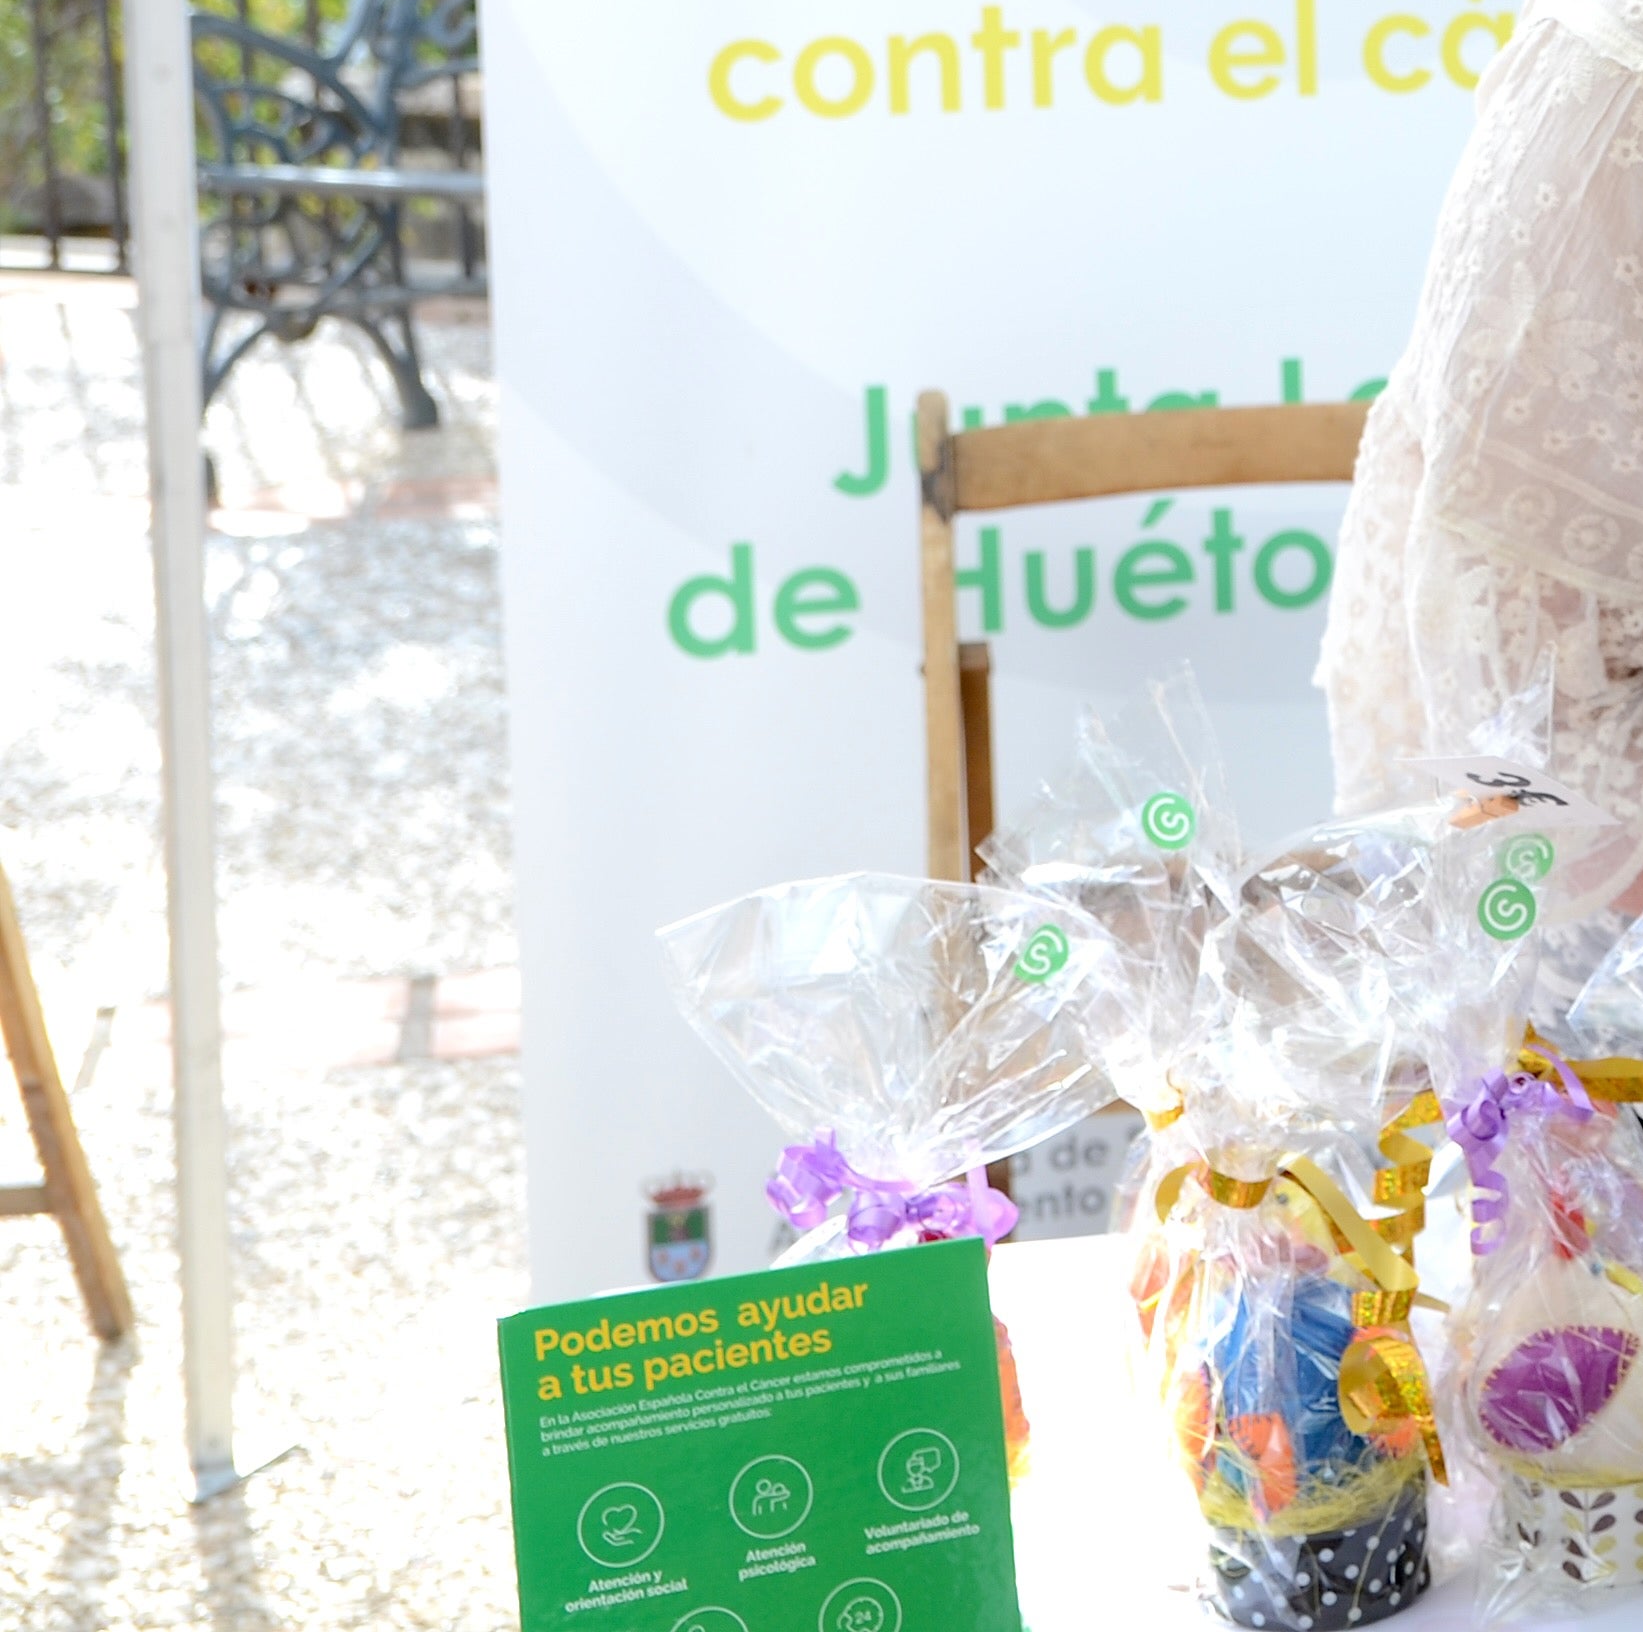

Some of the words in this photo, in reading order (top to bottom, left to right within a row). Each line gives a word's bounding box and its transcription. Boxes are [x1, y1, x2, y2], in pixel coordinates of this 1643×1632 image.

[707, 5, 1164, 123] contra
[667, 541, 860, 660] de
[1049, 1136, 1108, 1168] de
[534, 1308, 720, 1361] Podemos
[737, 1282, 868, 1332] ayudar
[538, 1374, 562, 1401] a
[571, 1363, 634, 1394] tus
[643, 1329, 832, 1391] pacientes
[539, 1415, 556, 1429] En
[558, 1413, 570, 1425] la
[572, 1402, 637, 1423] Asociación
[638, 1392, 693, 1413] Española
[694, 1385, 735, 1402] Contra
[736, 1381, 748, 1394] el
[750, 1375, 791, 1392] Cáncer
[793, 1368, 842, 1384] estamos
[844, 1351, 933, 1376] comprometidos
[935, 1350, 942, 1360] a
[540, 1426, 584, 1443] brindar
[587, 1406, 690, 1435] acompañamiento
[692, 1391, 773, 1418] personalizado
[775, 1391, 783, 1401] a
[785, 1387, 803, 1400] tus
[805, 1377, 861, 1399] pacientes
[862, 1377, 870, 1388] y
[874, 1373, 883, 1384] a
[885, 1370, 904, 1382] sus
[906, 1359, 961, 1378] familiares
[542, 1446, 551, 1457] a
[552, 1438, 589, 1455] través
[592, 1434, 608, 1448] de
[610, 1427, 663, 1445] nuestros
[665, 1417, 716, 1436] servicios
[864, 1515, 949, 1540] Voluntariado
[951, 1510, 969, 1524] de
[865, 1523, 980, 1555] acompañamiento
[738, 1555, 816, 1582] psicológica
[746, 1541, 806, 1563] Atención
[564, 1589, 645, 1614] orientación
[647, 1578, 688, 1598] social
[588, 1571, 651, 1593] Atención
[653, 1568, 662, 1583] y
